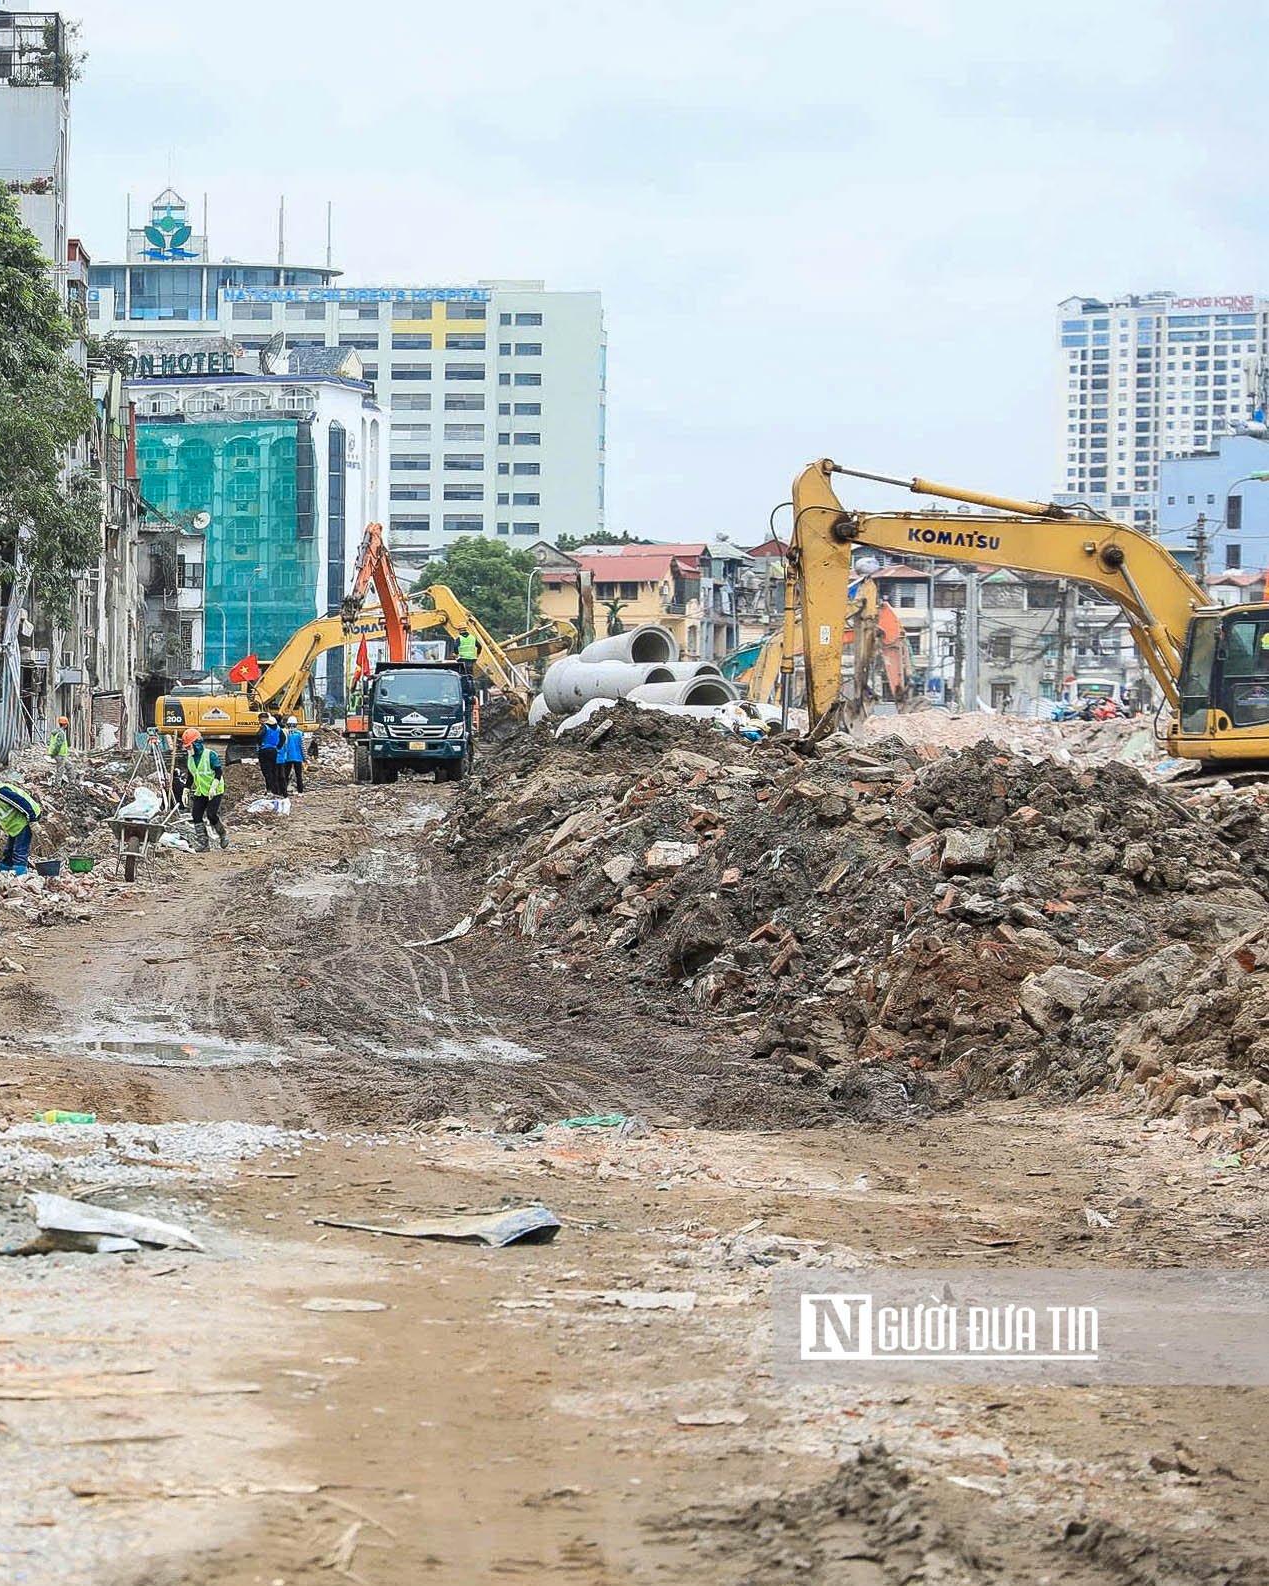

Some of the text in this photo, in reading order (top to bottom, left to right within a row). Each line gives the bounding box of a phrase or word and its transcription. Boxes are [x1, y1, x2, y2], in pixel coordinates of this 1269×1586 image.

[224, 287, 490, 302] NATIONAL CHILDREN'S HOSPITAL
[1171, 295, 1254, 309] HONG KONG
[161, 351, 235, 378] HOTEL
[907, 527, 1001, 551] KOMATSU
